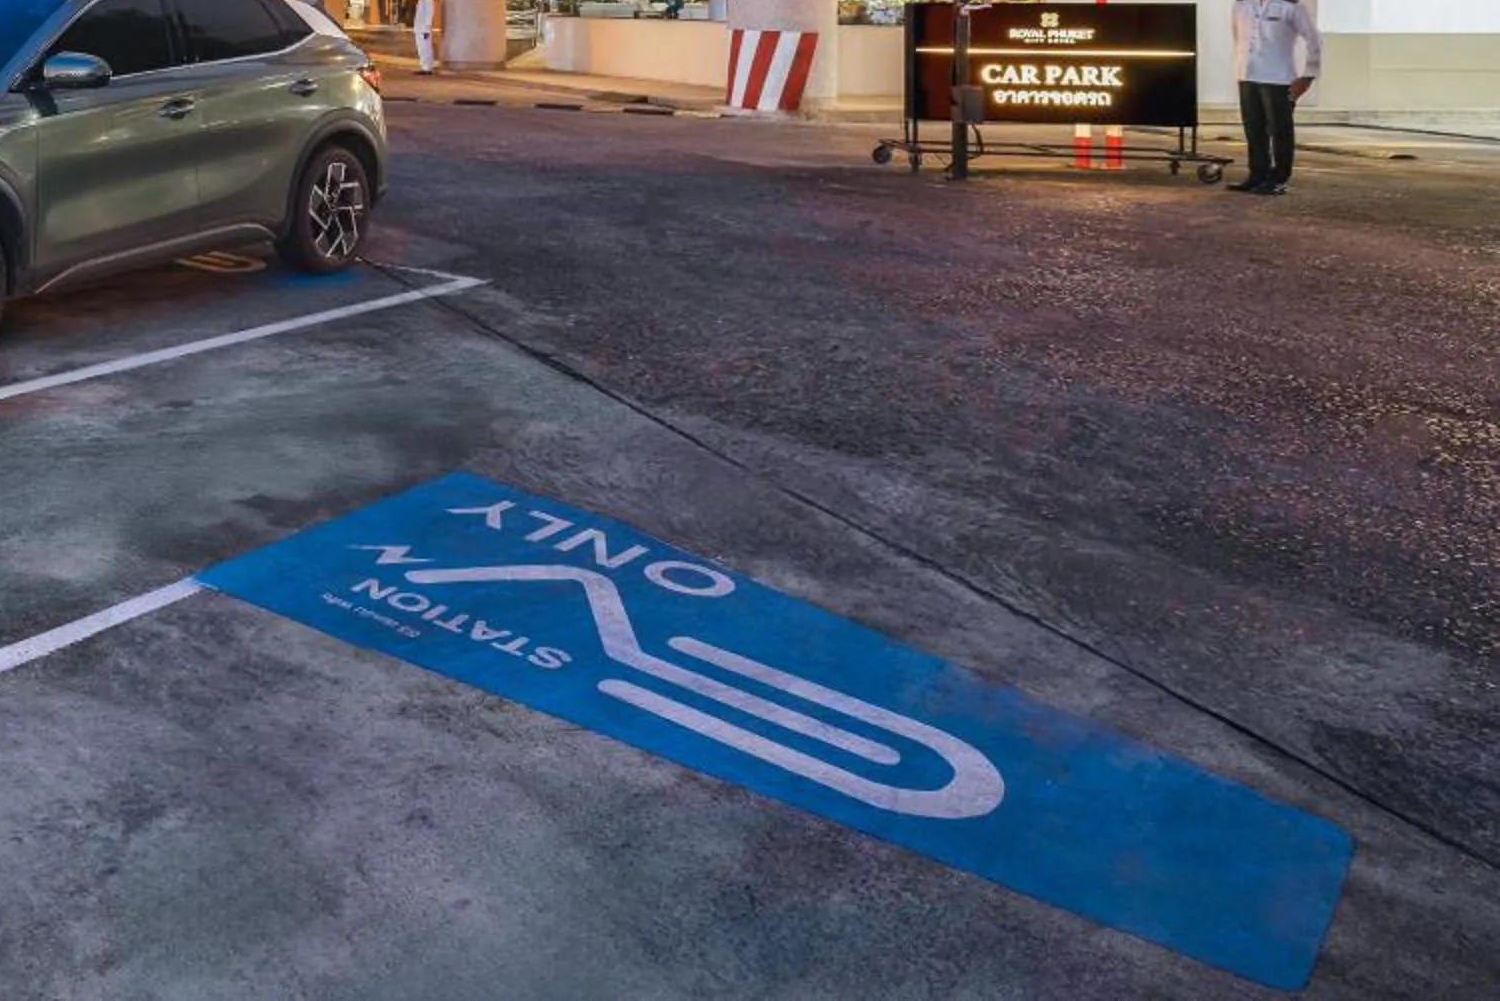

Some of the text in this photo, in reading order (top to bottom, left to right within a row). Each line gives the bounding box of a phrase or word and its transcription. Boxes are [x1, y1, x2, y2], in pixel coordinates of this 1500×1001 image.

[980, 64, 1123, 87] CAR PARK
[444, 501, 736, 596] ONLY
[351, 579, 573, 669] STATION
